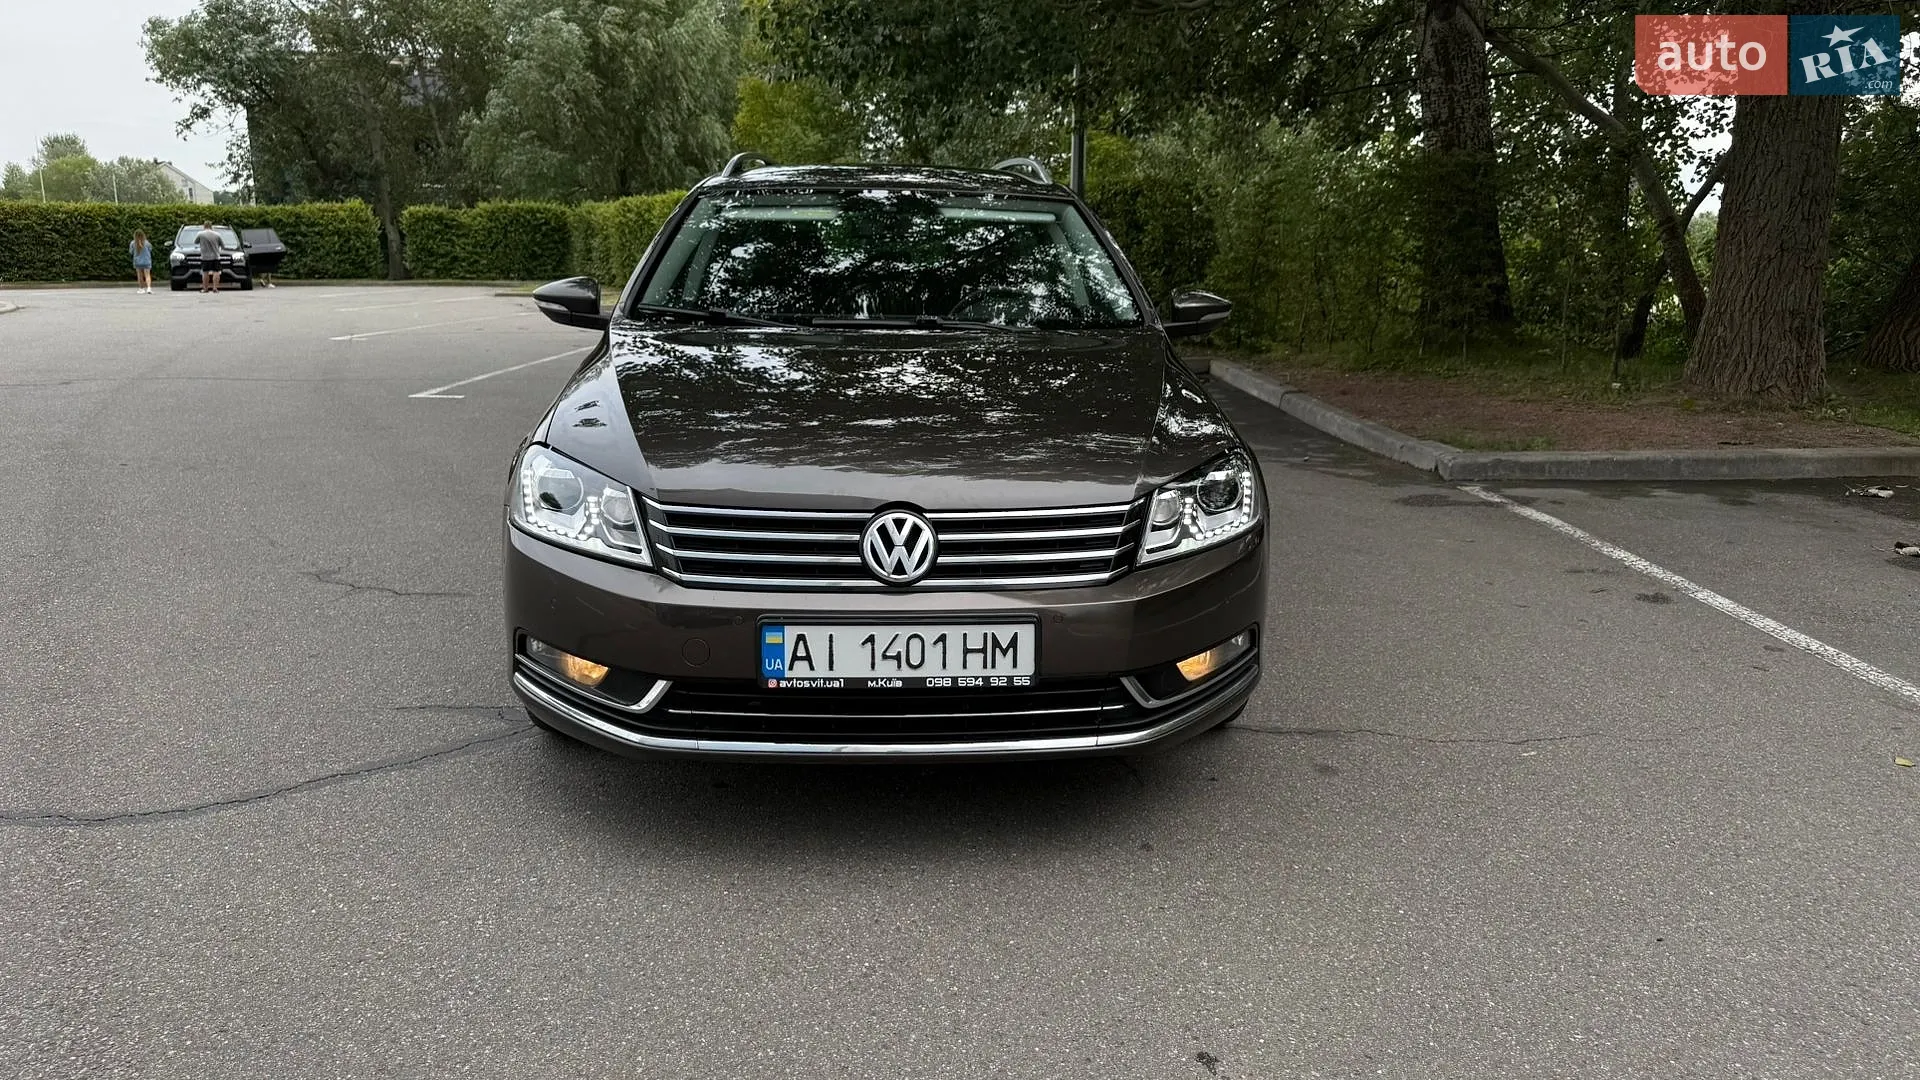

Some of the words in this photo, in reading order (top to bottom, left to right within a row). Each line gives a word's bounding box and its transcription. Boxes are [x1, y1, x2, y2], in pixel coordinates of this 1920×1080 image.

[788, 632, 834, 671] AI
[860, 632, 947, 671] 1401
[962, 632, 1018, 670] HM
[765, 658, 783, 671] UA
[926, 677, 951, 687] 098
[958, 677, 983, 687] 594
[990, 677, 1007, 687] 92
[1014, 677, 1030, 687] 55
